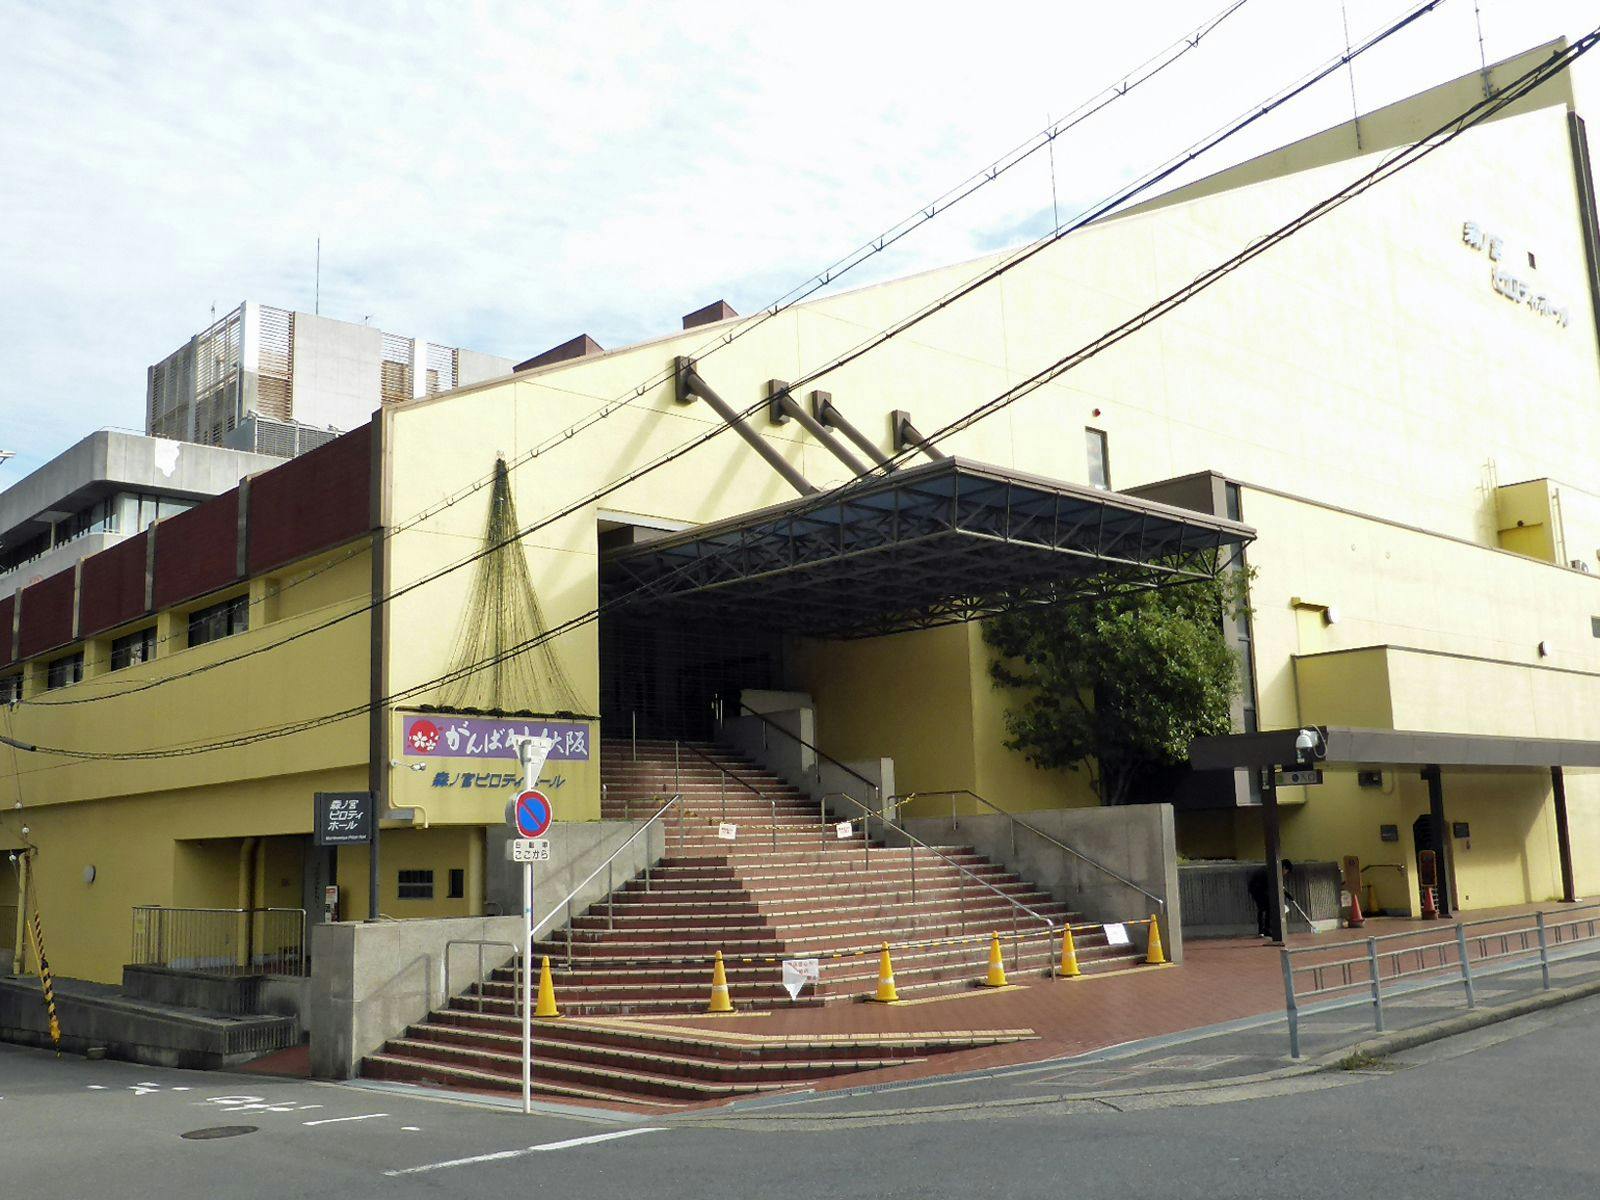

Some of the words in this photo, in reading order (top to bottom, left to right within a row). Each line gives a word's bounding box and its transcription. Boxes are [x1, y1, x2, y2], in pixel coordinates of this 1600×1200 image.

[445, 721, 588, 756] がんば大阪
[431, 771, 567, 789] 森ノ宮ピロティール
[329, 799, 359, 810] 森ノ宮
[329, 810, 364, 821] ピロティ
[327, 820, 359, 832] ホール
[515, 850, 549, 860] ここから
